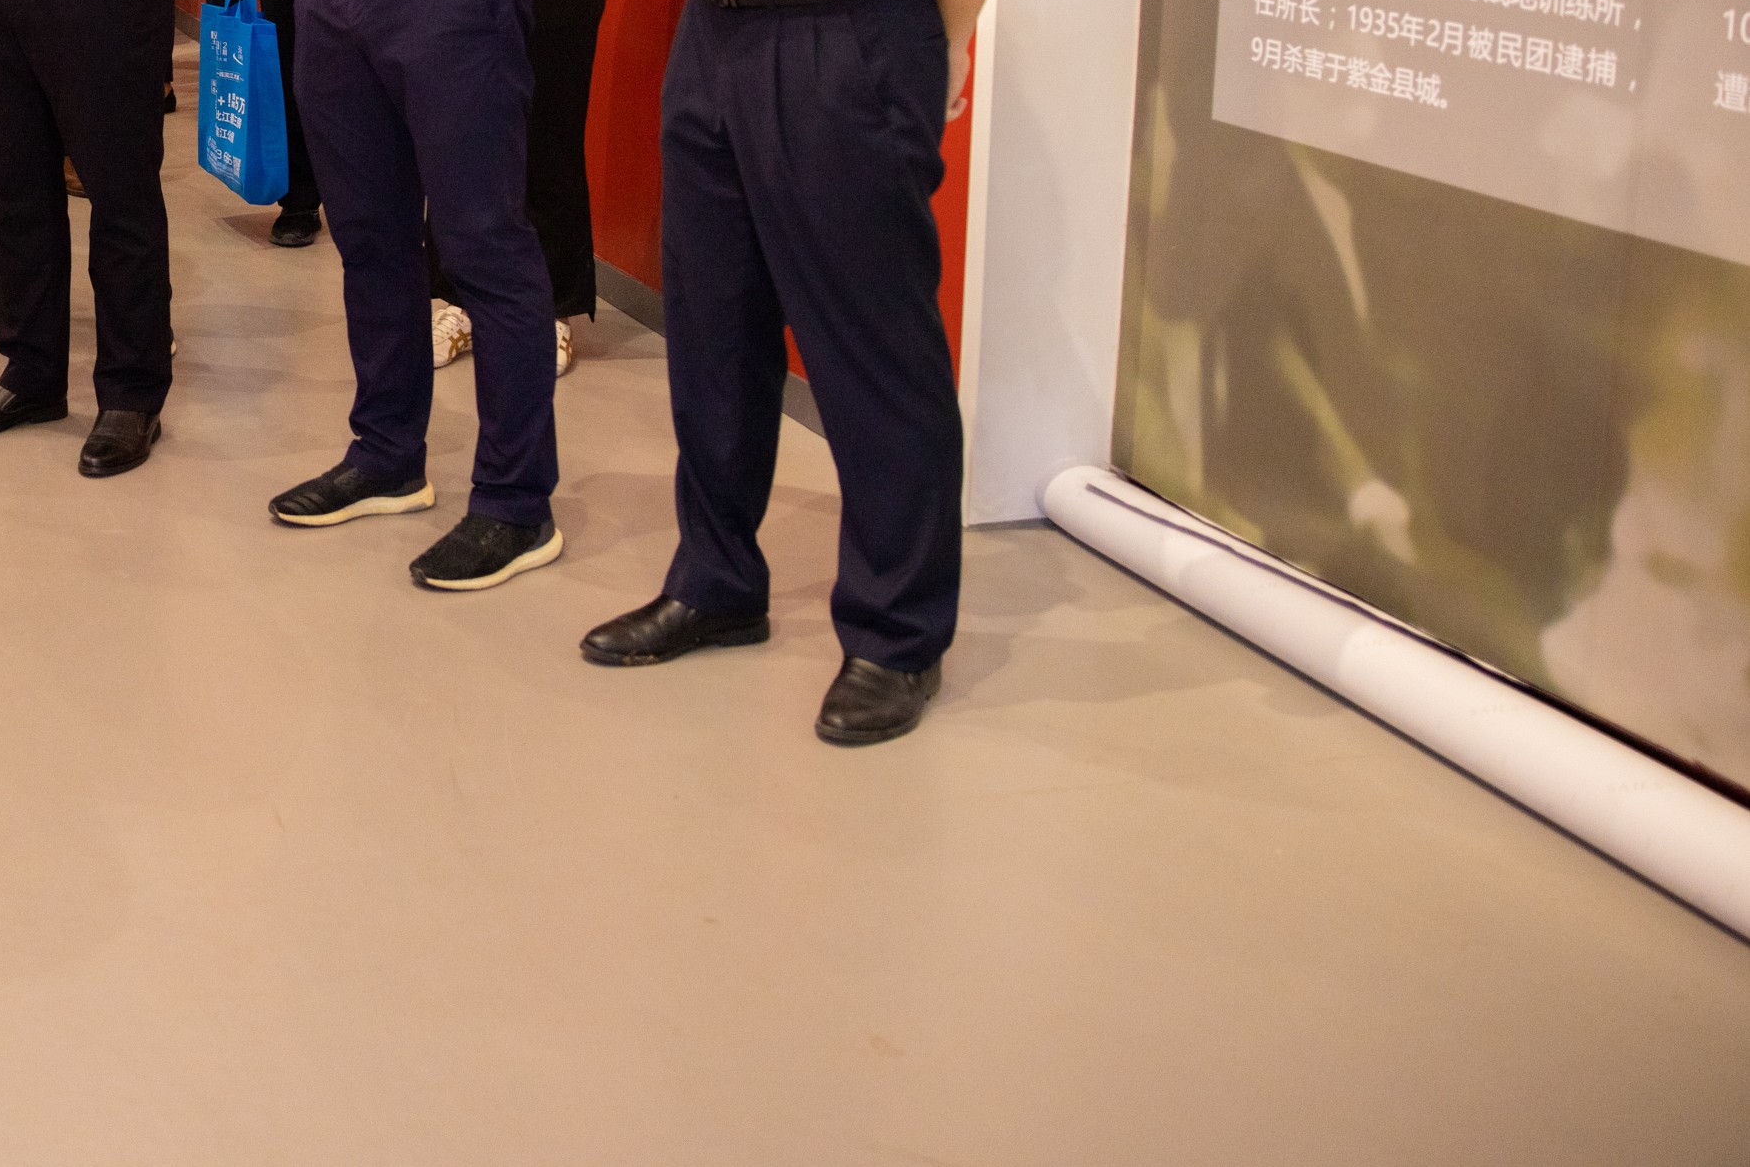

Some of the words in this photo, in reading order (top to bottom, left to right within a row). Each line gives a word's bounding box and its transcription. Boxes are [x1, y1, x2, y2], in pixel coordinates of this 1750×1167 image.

[1250, 36, 1449, 109] 9月杀害于紫金县城。
